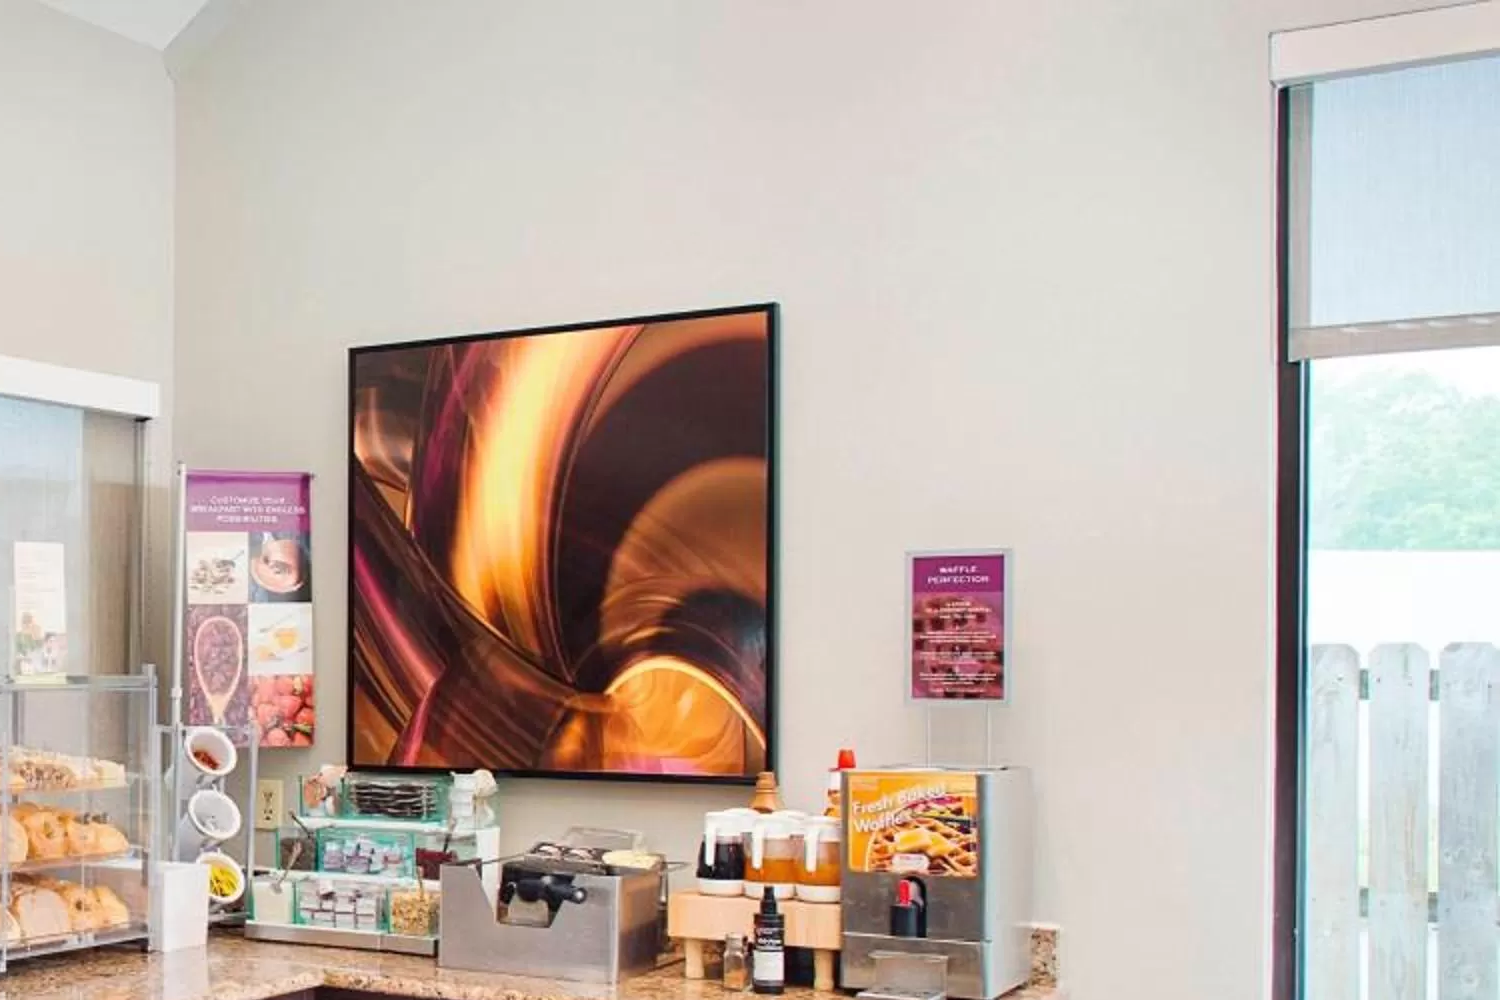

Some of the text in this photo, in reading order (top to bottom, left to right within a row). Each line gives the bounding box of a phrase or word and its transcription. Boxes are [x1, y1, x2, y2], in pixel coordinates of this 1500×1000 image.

[939, 565, 978, 574] WAFFLE
[927, 575, 990, 584] PERFECTION
[853, 796, 894, 814] Fresh
